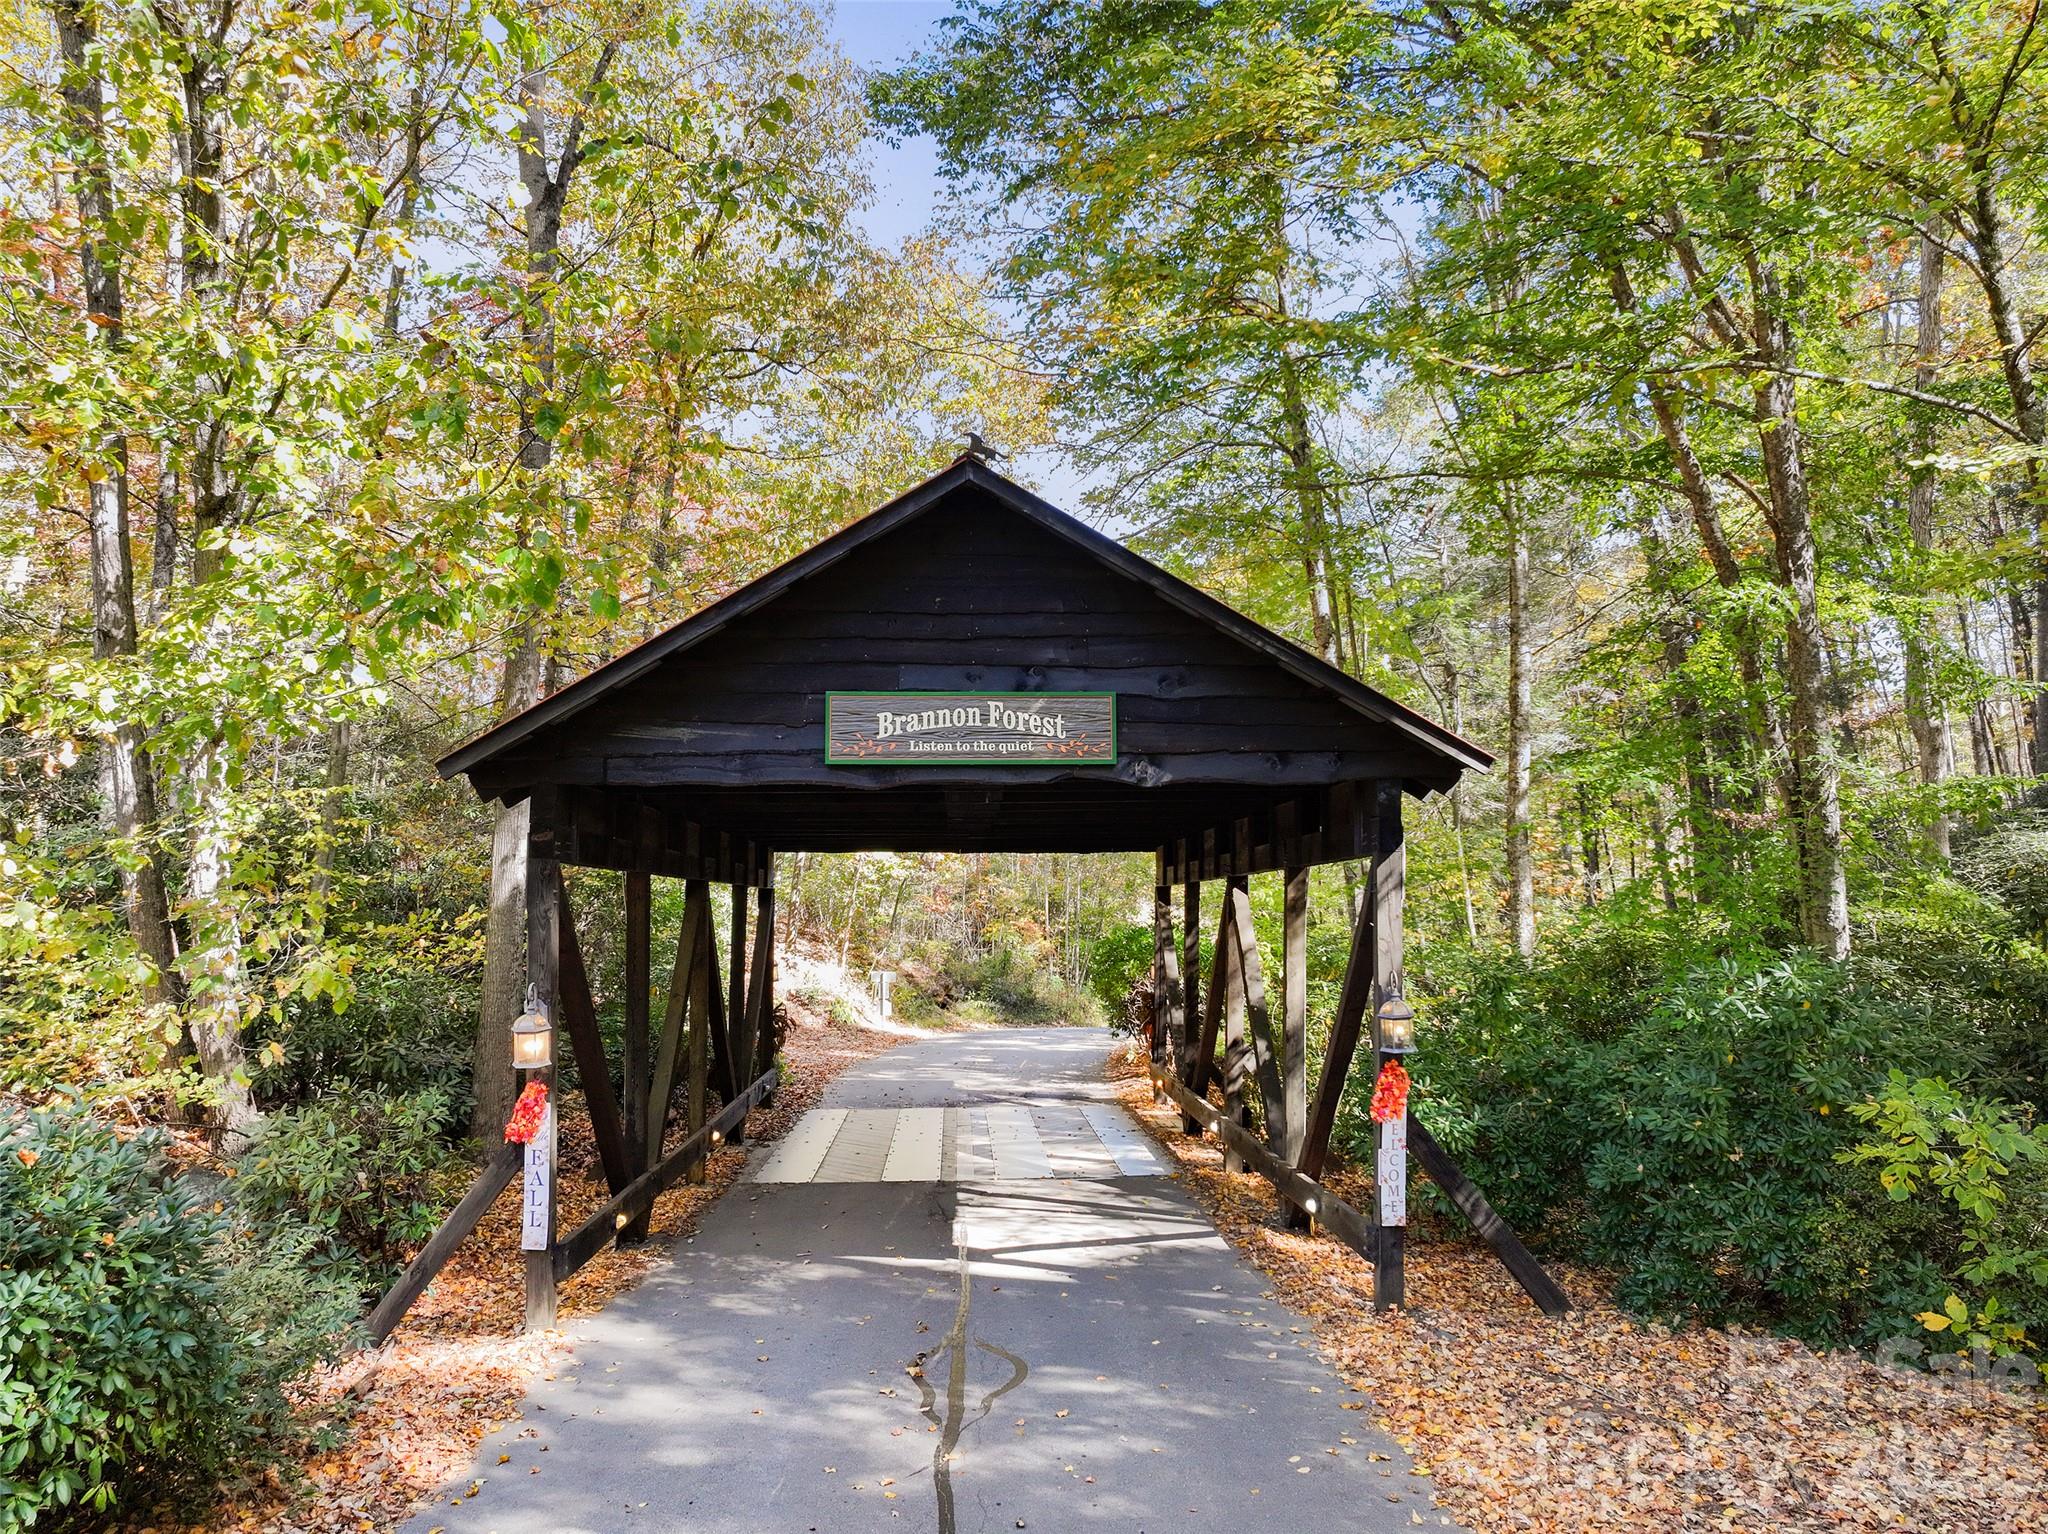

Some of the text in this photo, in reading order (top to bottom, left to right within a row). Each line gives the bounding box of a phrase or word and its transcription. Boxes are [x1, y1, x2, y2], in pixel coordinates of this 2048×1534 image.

[876, 700, 1067, 740] Brannon Forest
[909, 740, 1035, 754] Listen to the quiet
[1387, 1123, 1400, 1213] ELCOME
